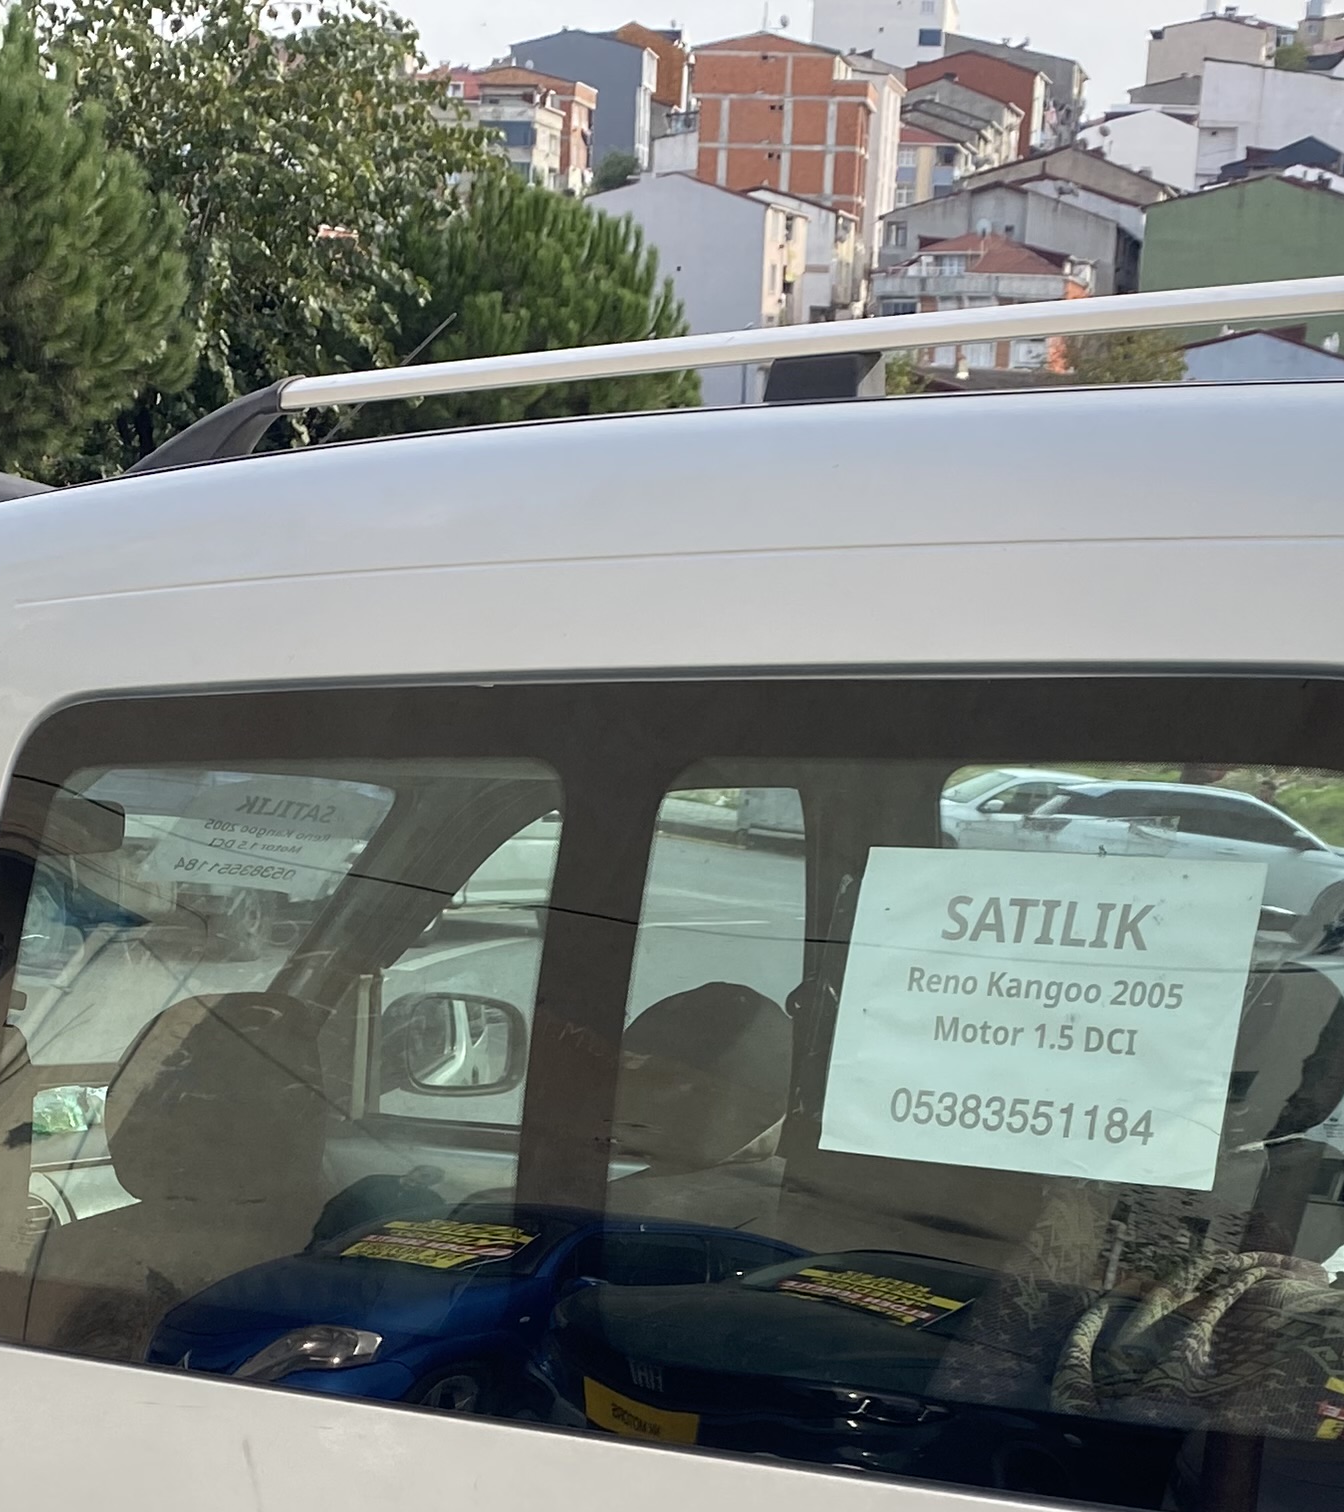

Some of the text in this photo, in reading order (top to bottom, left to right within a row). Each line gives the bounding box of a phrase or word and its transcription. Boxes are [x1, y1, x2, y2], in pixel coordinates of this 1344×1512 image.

[940, 895, 1156, 951] SATILIK
[906, 966, 1184, 1010] Reno Kangoo 2005
[933, 1015, 1138, 1056] Motor 1.5 DCI
[889, 1087, 1155, 1146] 05383551184
